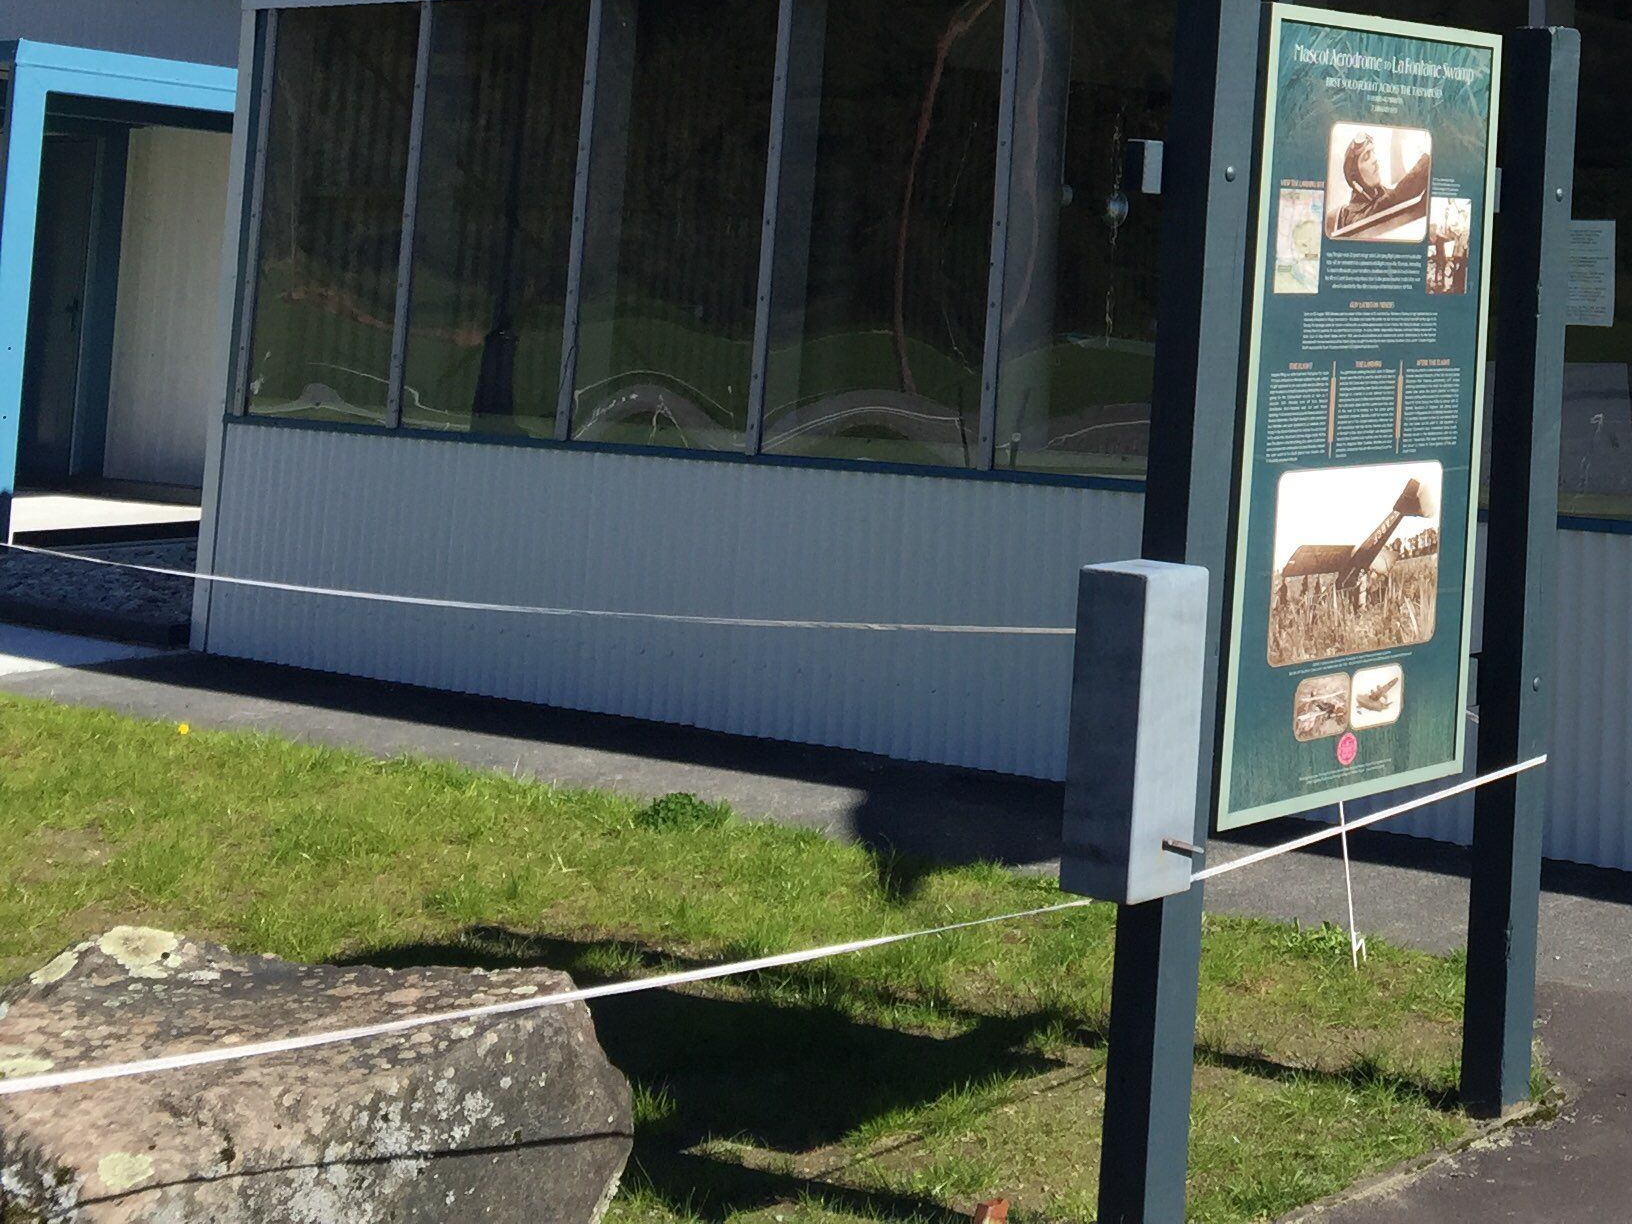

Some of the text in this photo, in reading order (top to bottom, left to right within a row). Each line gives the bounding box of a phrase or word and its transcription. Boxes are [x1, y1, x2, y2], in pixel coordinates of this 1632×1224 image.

[1293, 43, 1329, 65] Mascot
[1329, 48, 1383, 71] Aerodrome
[1392, 55, 1405, 74] La
[1405, 57, 1442, 78] Fontaine
[1442, 62, 1475, 85] Swamp
